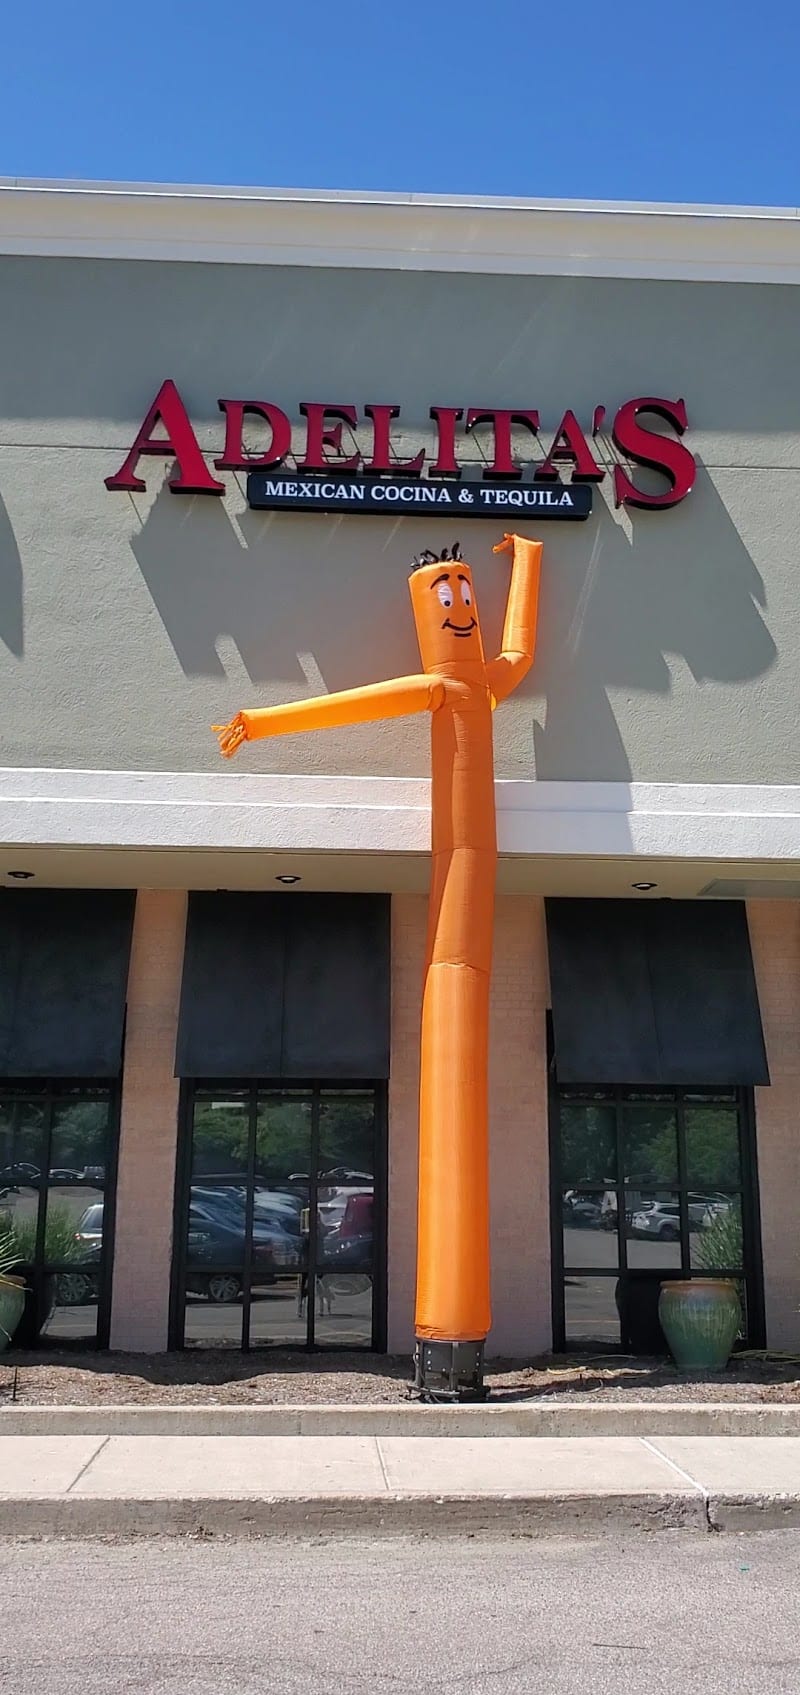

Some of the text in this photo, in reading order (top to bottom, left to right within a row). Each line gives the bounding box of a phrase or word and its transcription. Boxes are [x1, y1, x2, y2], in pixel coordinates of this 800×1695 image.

[104, 379, 697, 510] ADELITA'S
[265, 481, 574, 507] MEXICAN COCINA & TEQUILA
